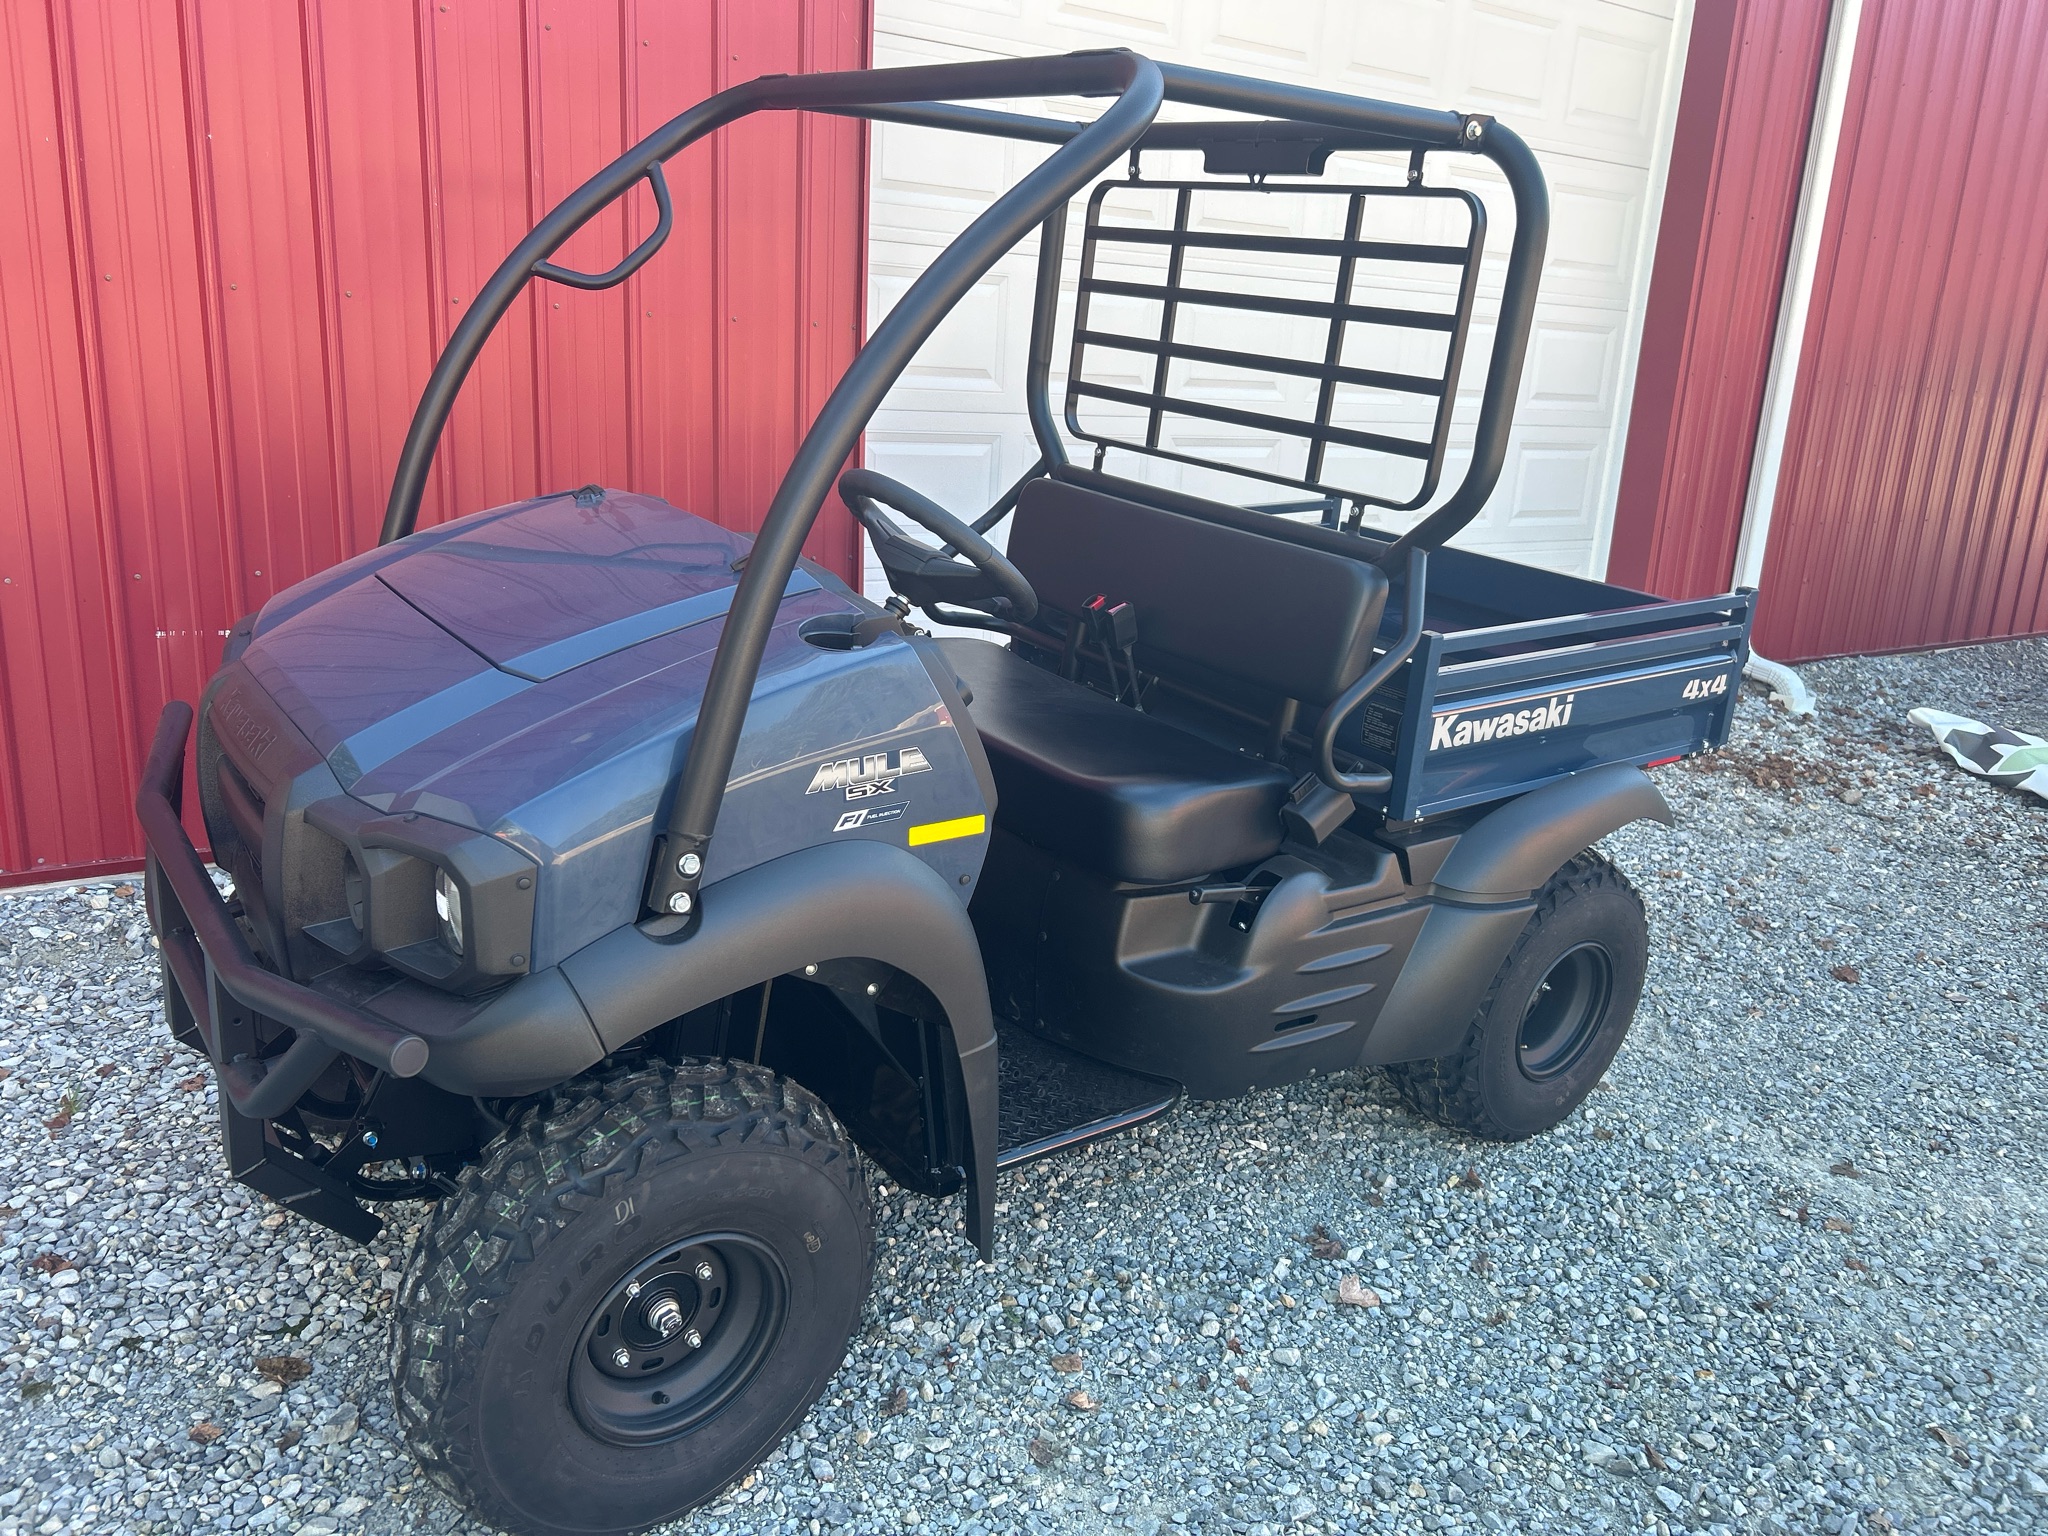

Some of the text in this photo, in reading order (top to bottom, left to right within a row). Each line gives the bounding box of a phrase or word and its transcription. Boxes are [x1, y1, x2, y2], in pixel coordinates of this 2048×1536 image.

[1682, 673, 1728, 701] 4x4
[1429, 694, 1575, 752] Kawasaki
[805, 746, 933, 795] MULE
[846, 777, 896, 801] SX
